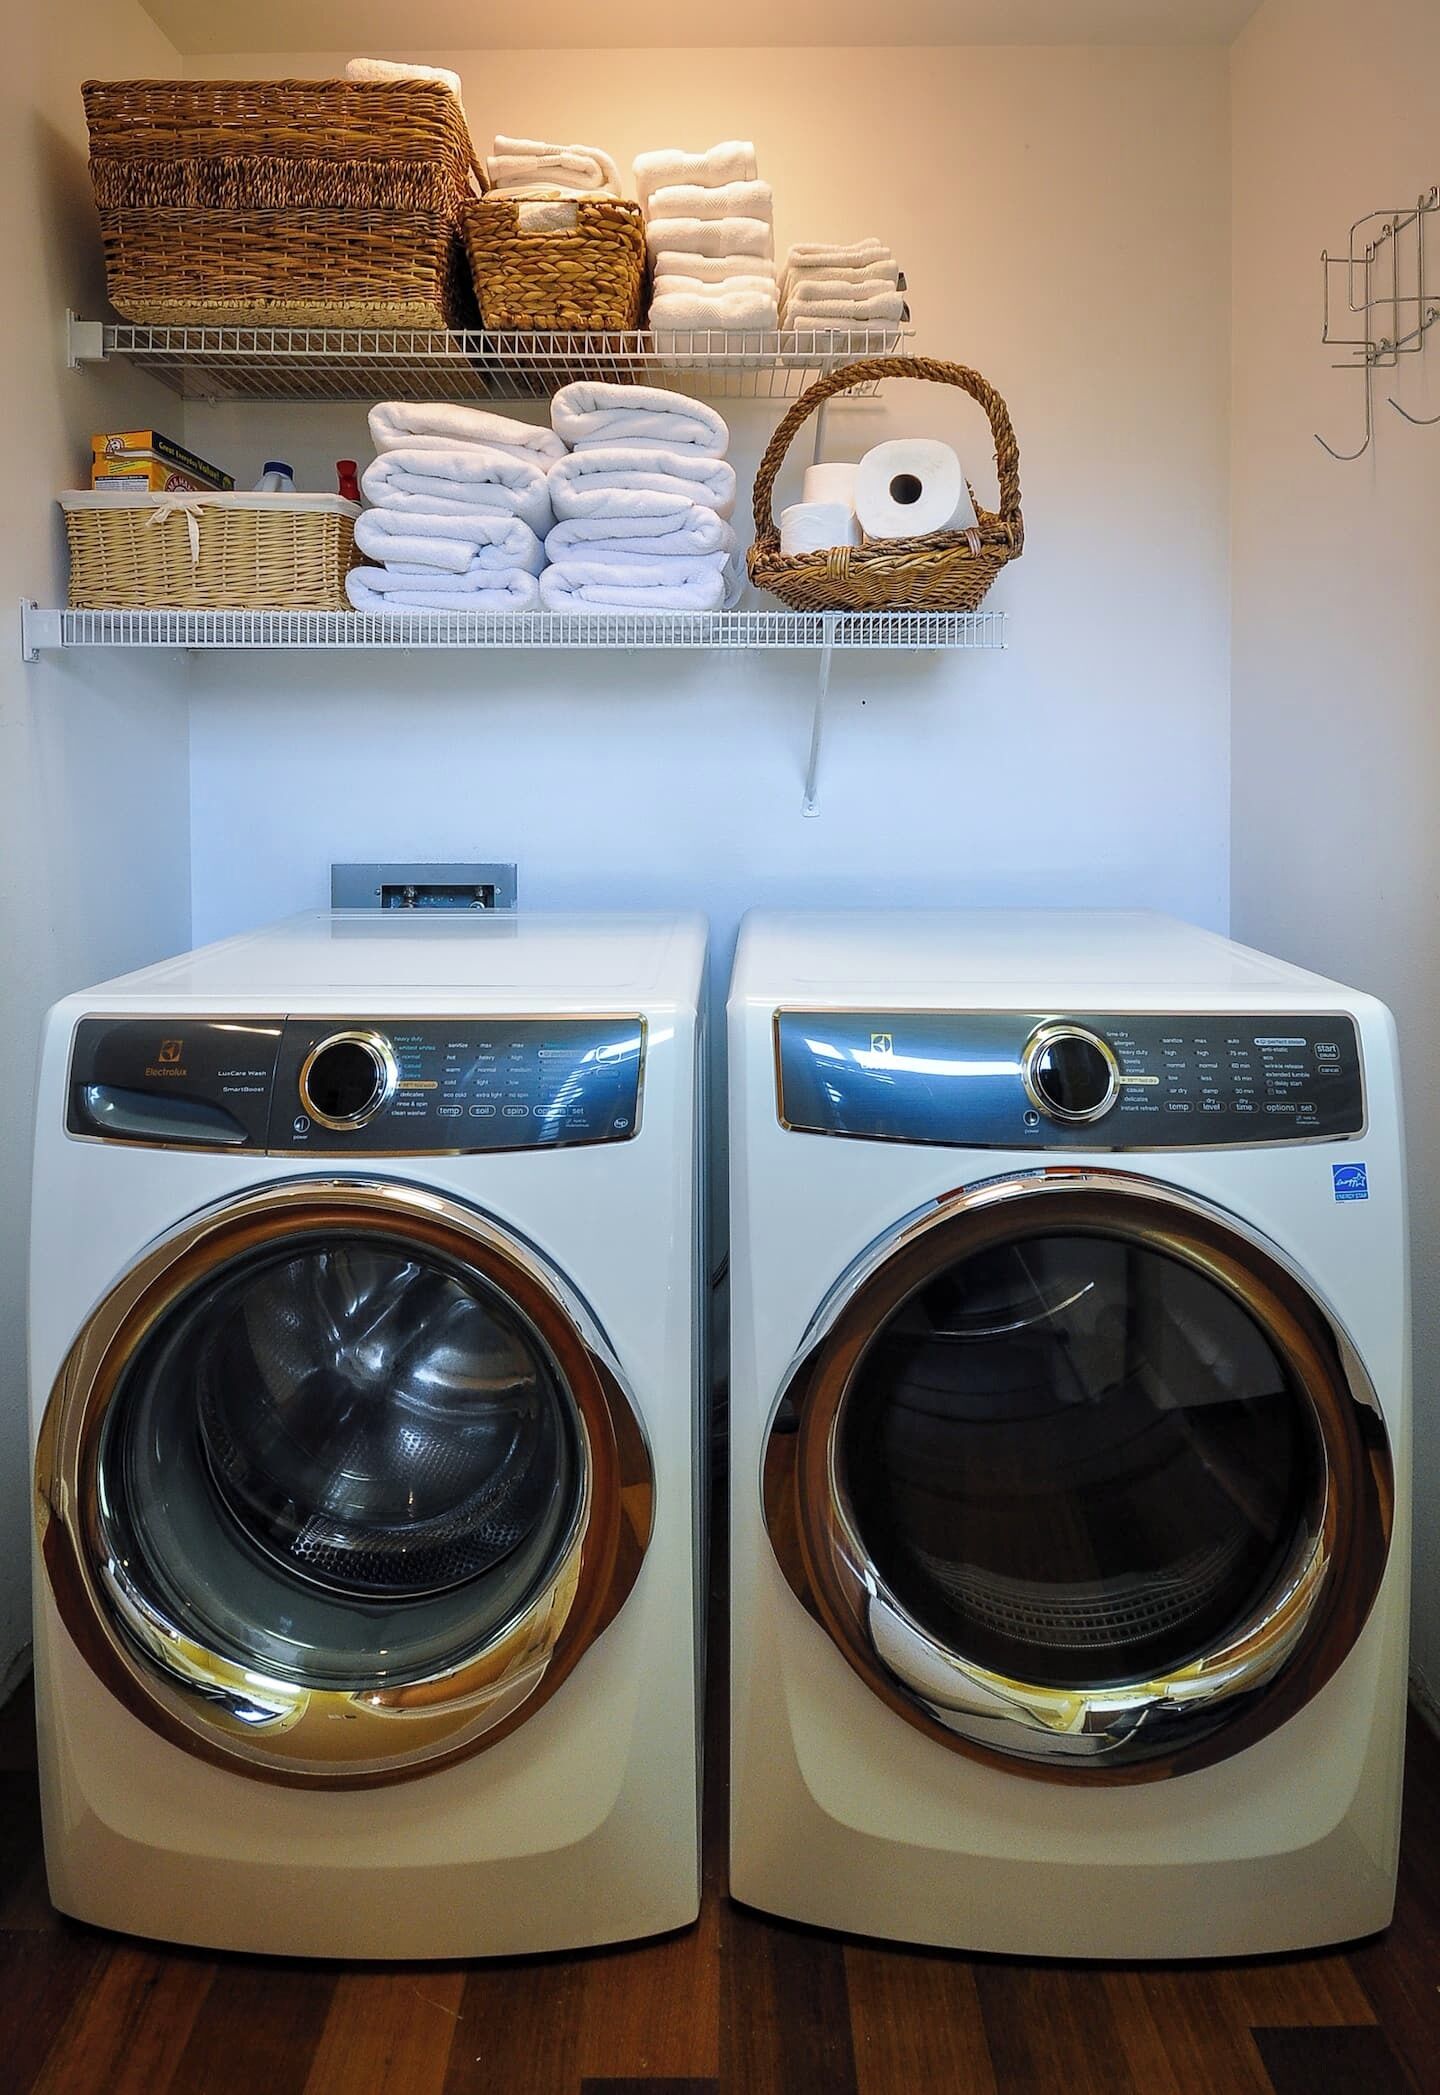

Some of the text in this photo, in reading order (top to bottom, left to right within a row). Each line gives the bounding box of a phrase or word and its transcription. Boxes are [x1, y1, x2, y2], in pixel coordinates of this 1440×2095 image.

[144, 1068, 187, 1077] Electrolux
[440, 1106, 460, 1115] temp
[507, 1107, 524, 1115] spin
[572, 1107, 584, 1115] set
[1267, 1103, 1295, 1112] options
